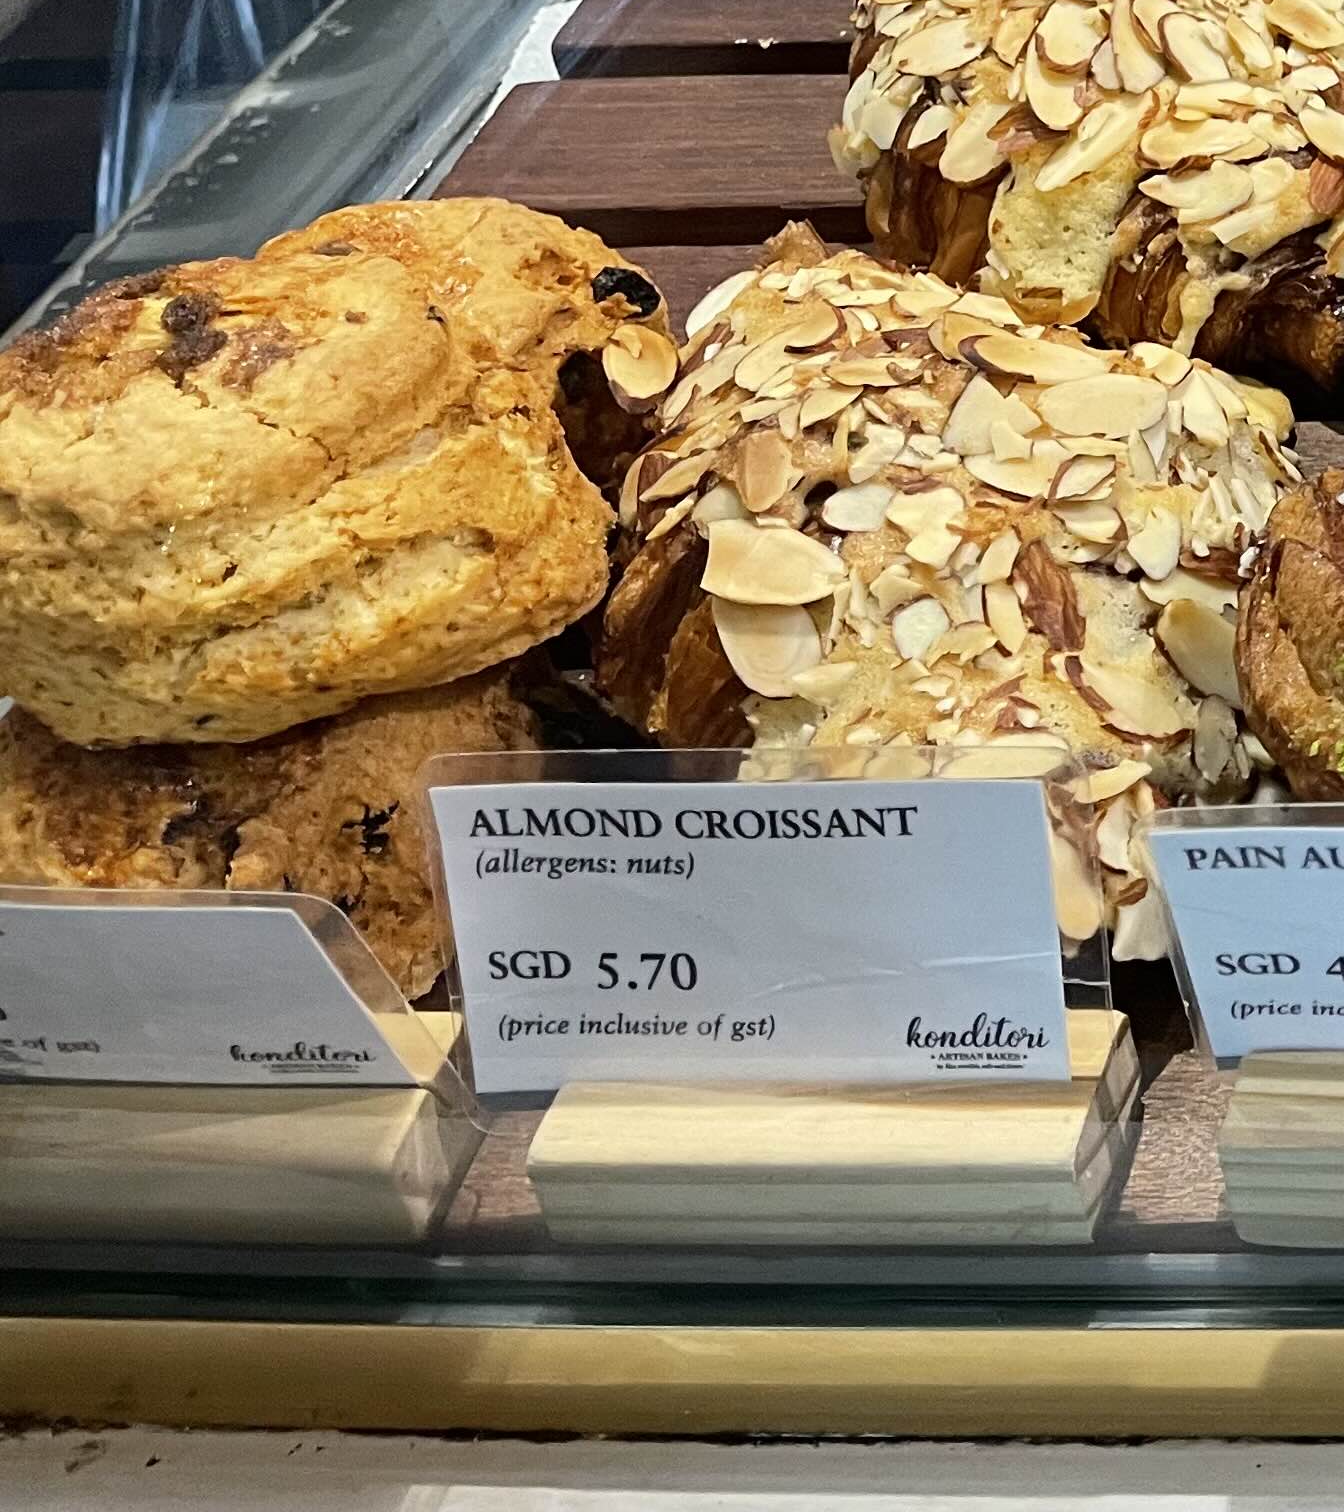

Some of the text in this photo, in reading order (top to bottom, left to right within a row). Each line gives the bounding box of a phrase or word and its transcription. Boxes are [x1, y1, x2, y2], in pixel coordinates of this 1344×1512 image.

[469, 805, 919, 839] ALMOND CROISSANT
[474, 848, 696, 880] (allergens: nuts)
[1183, 845, 1287, 871] PAIN
[487, 950, 699, 991] SGD 5.70
[1215, 953, 1301, 976] SGD
[1230, 999, 1303, 1021] (price
[498, 1012, 775, 1042] (price inclusive of gst)
[905, 1011, 1051, 1049] konditori
